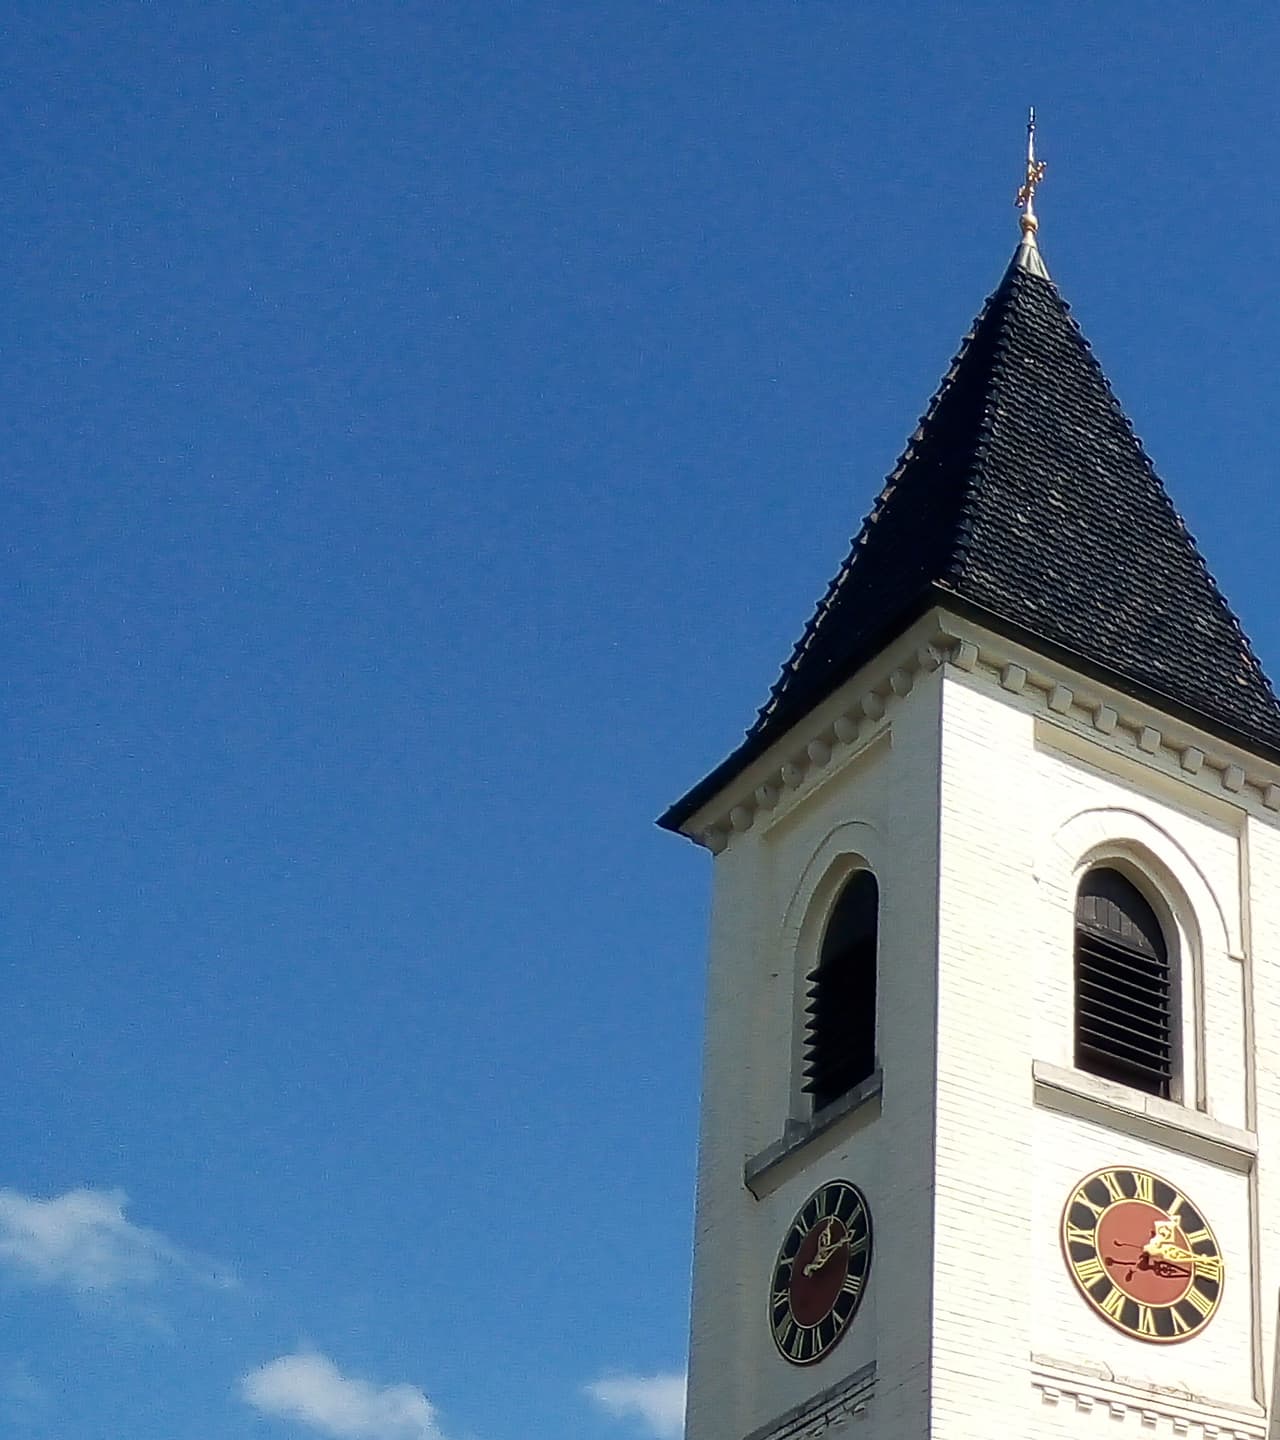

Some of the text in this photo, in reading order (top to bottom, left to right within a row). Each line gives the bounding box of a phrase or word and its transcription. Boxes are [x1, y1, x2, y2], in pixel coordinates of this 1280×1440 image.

[1074, 1189, 1105, 1219] X
[1137, 1305, 1159, 1336] VI
[1170, 1307, 1191, 1334] V
